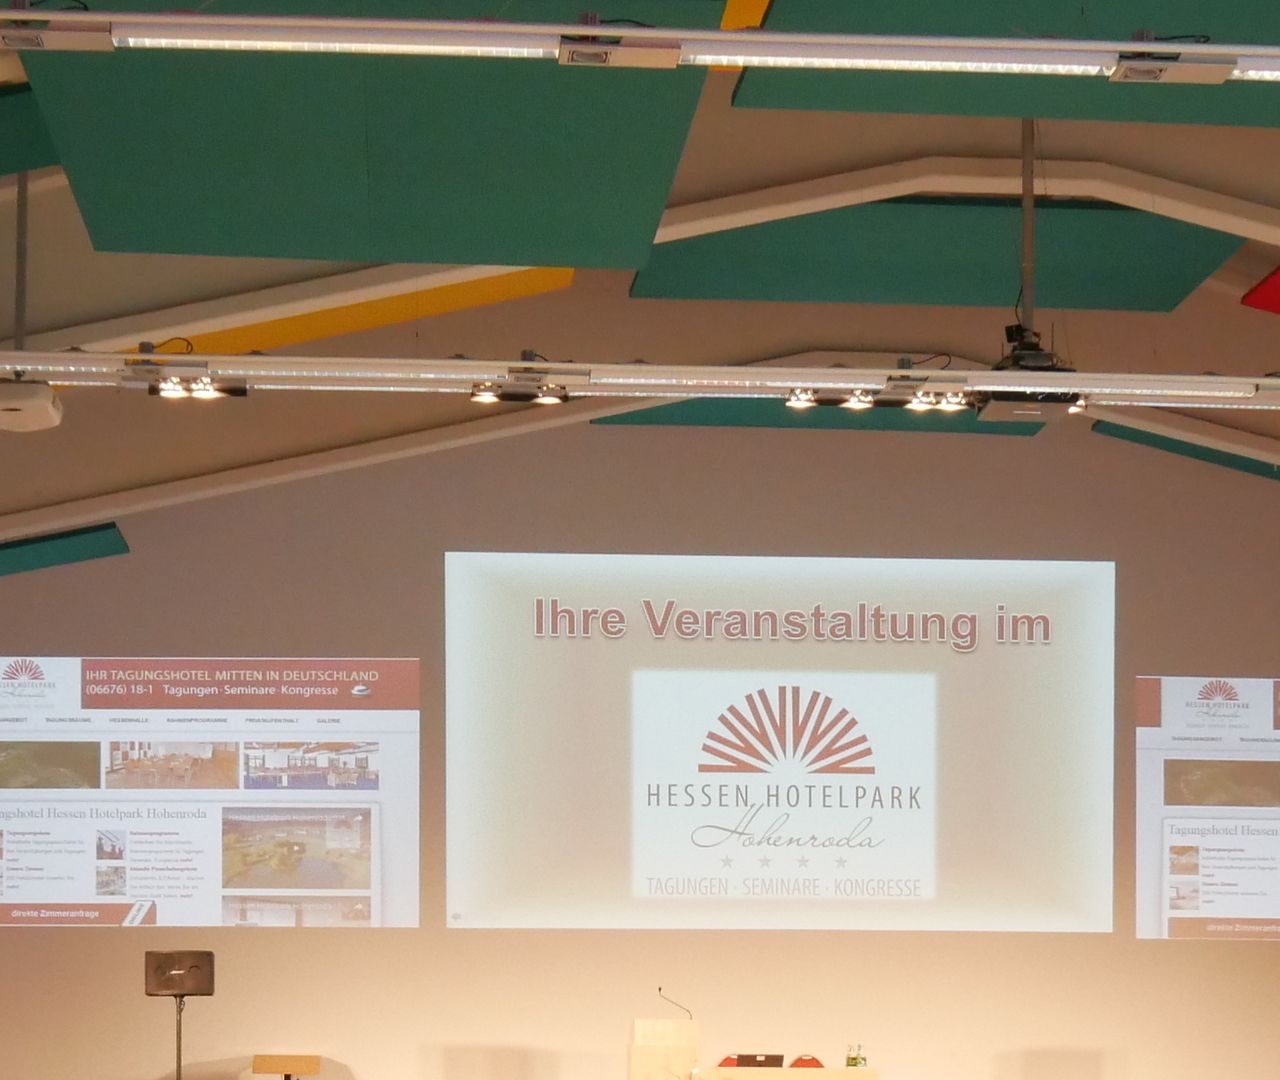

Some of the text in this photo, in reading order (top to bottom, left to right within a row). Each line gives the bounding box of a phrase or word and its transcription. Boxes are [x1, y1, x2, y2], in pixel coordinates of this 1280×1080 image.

[533, 596, 1053, 652] Ihre Veranstaltung im
[85, 670, 379, 682] IHR TAGUNGSHOTEL MITTEN IN DEUTSCHLAND
[85, 684, 339, 697] (06676) 18-1 Tagungen Seminare Kongresse
[646, 783, 922, 810] HESSEN HOTELPARK
[47, 807, 87, 820] Hessen
[89, 807, 143, 821] Hotelpark
[146, 807, 208, 820] Hohenroda
[690, 803, 886, 849] Hohenroda
[1168, 824, 1238, 838] Tagungshotel
[1240, 825, 1278, 837] Hessen
[646, 877, 921, 898] TAGUNGEN SEMINARE KONGRESSE
